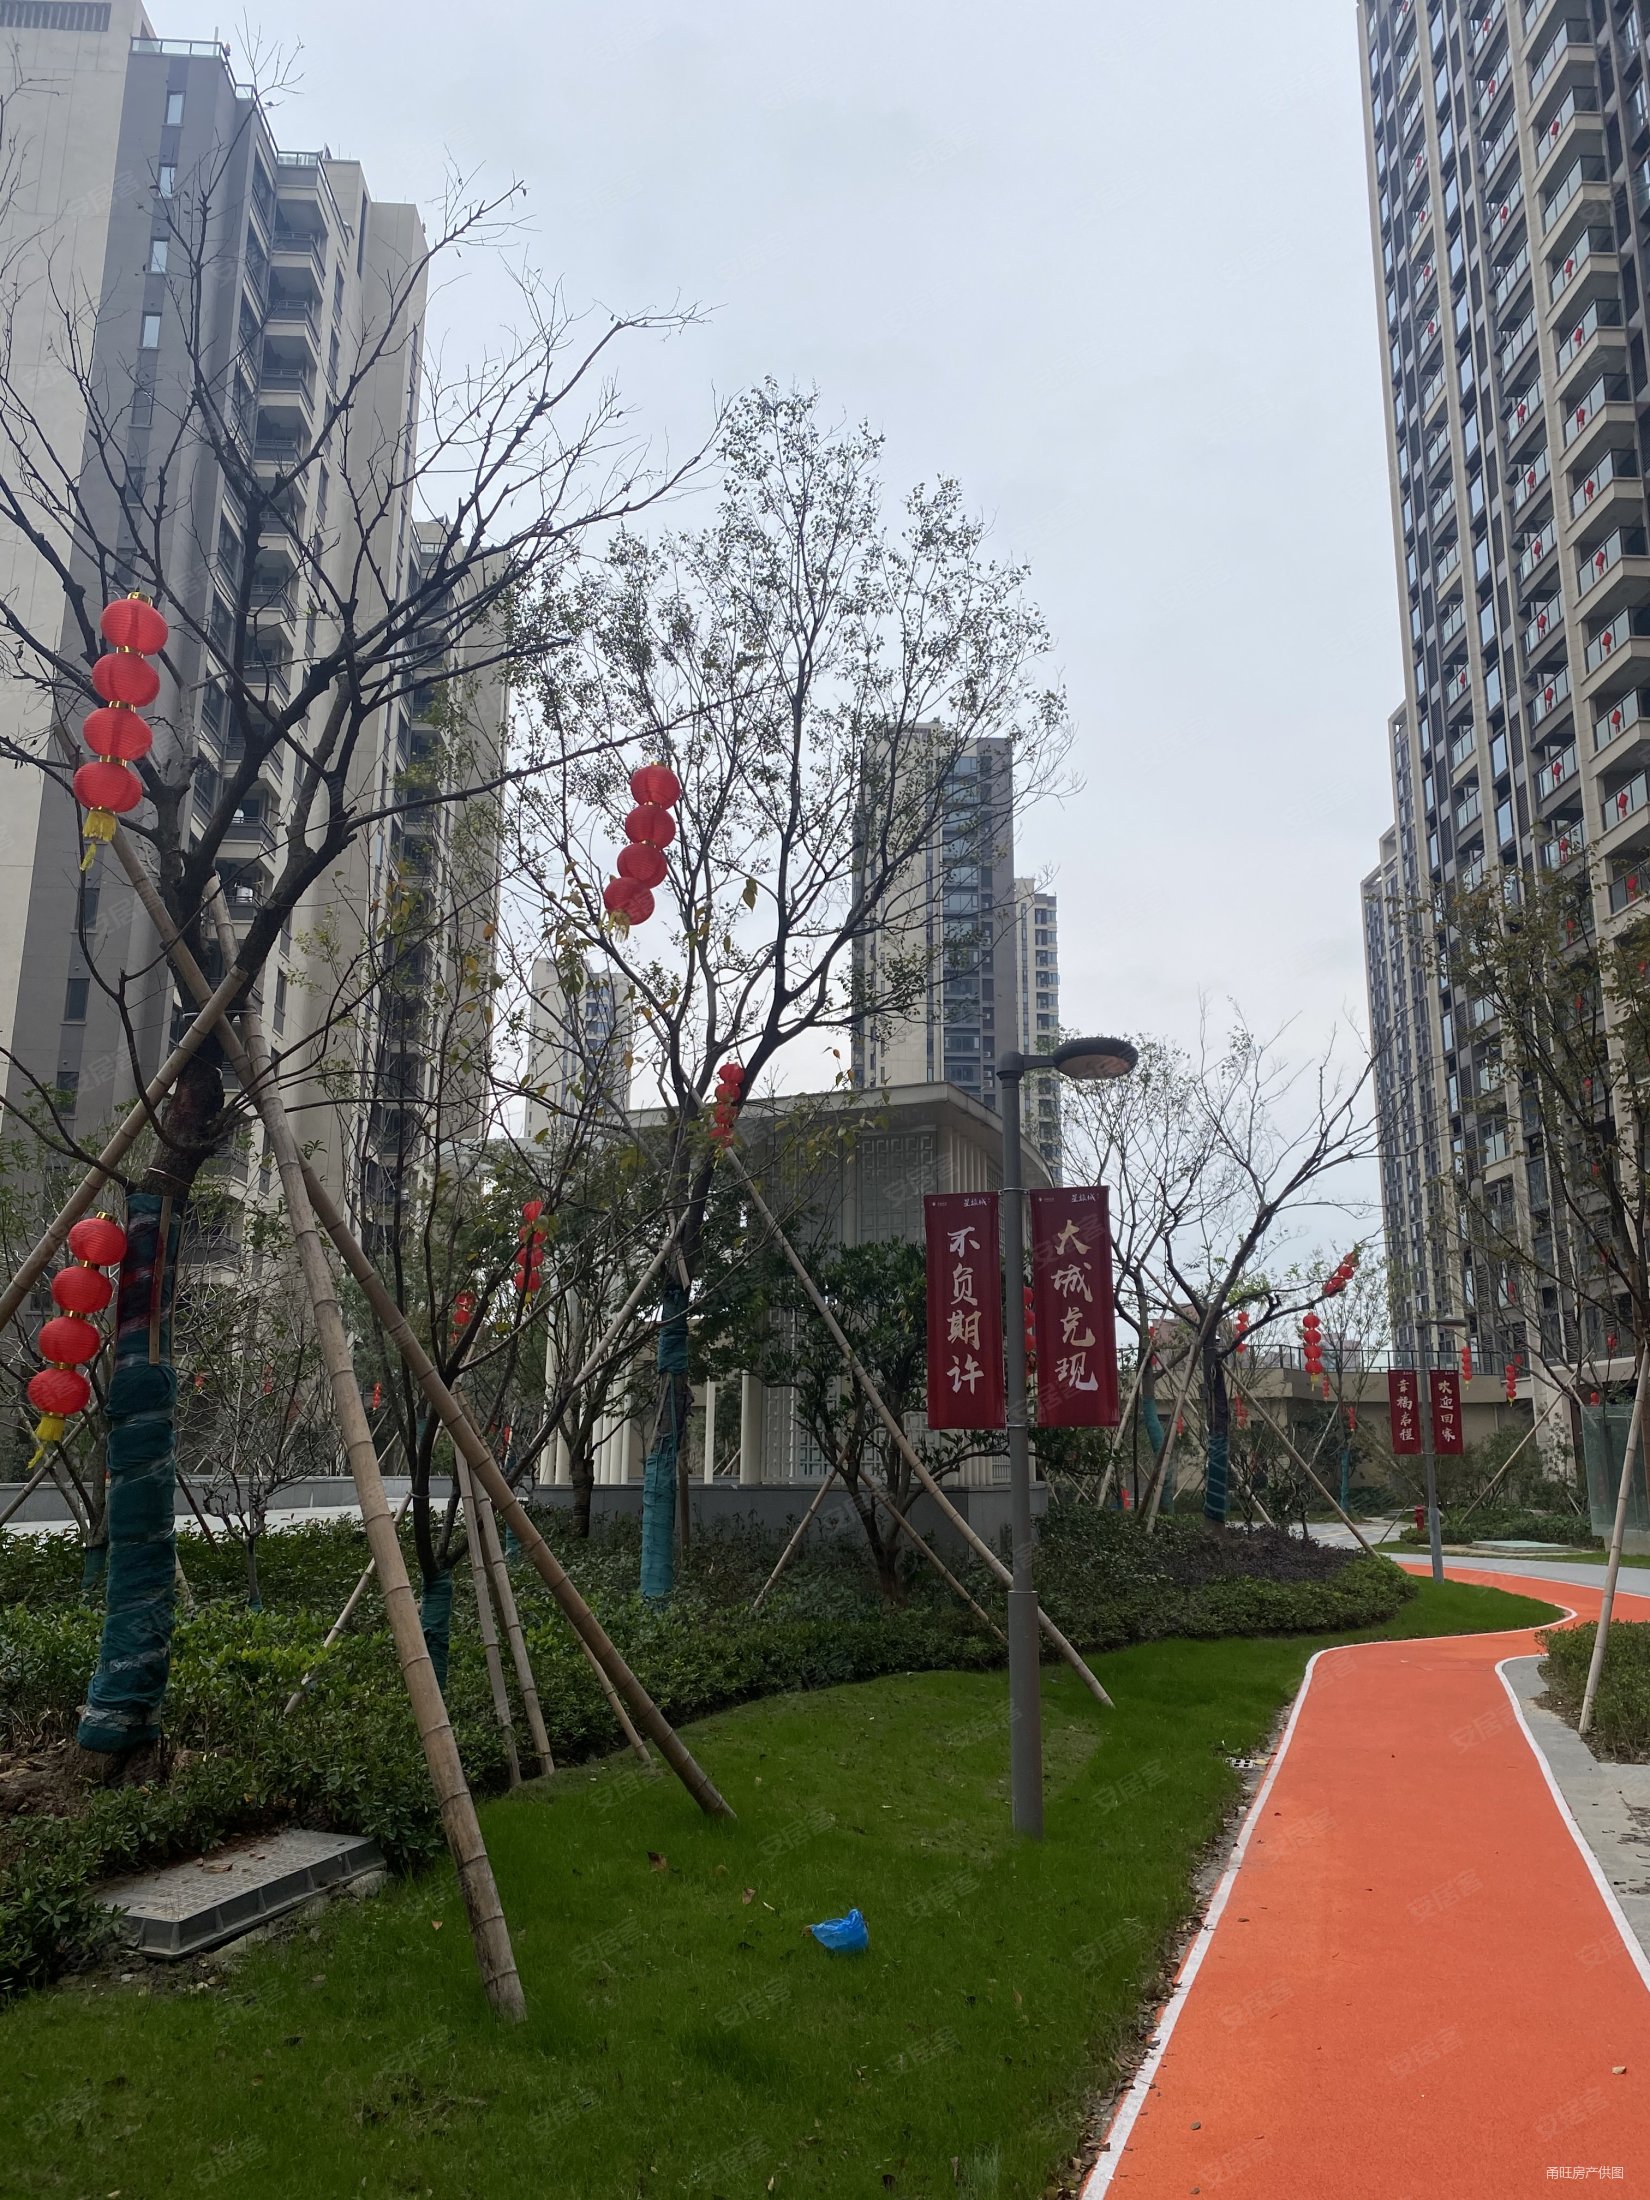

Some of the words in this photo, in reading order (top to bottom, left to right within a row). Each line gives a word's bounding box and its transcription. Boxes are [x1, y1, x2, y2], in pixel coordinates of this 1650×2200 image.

[946, 1226, 985, 1395] 不负期许
[1050, 1219, 1099, 1391] 大城兑现
[1396, 1379, 1415, 1441] 幸福启程
[1438, 1380, 1456, 1442] 欢迎回家
